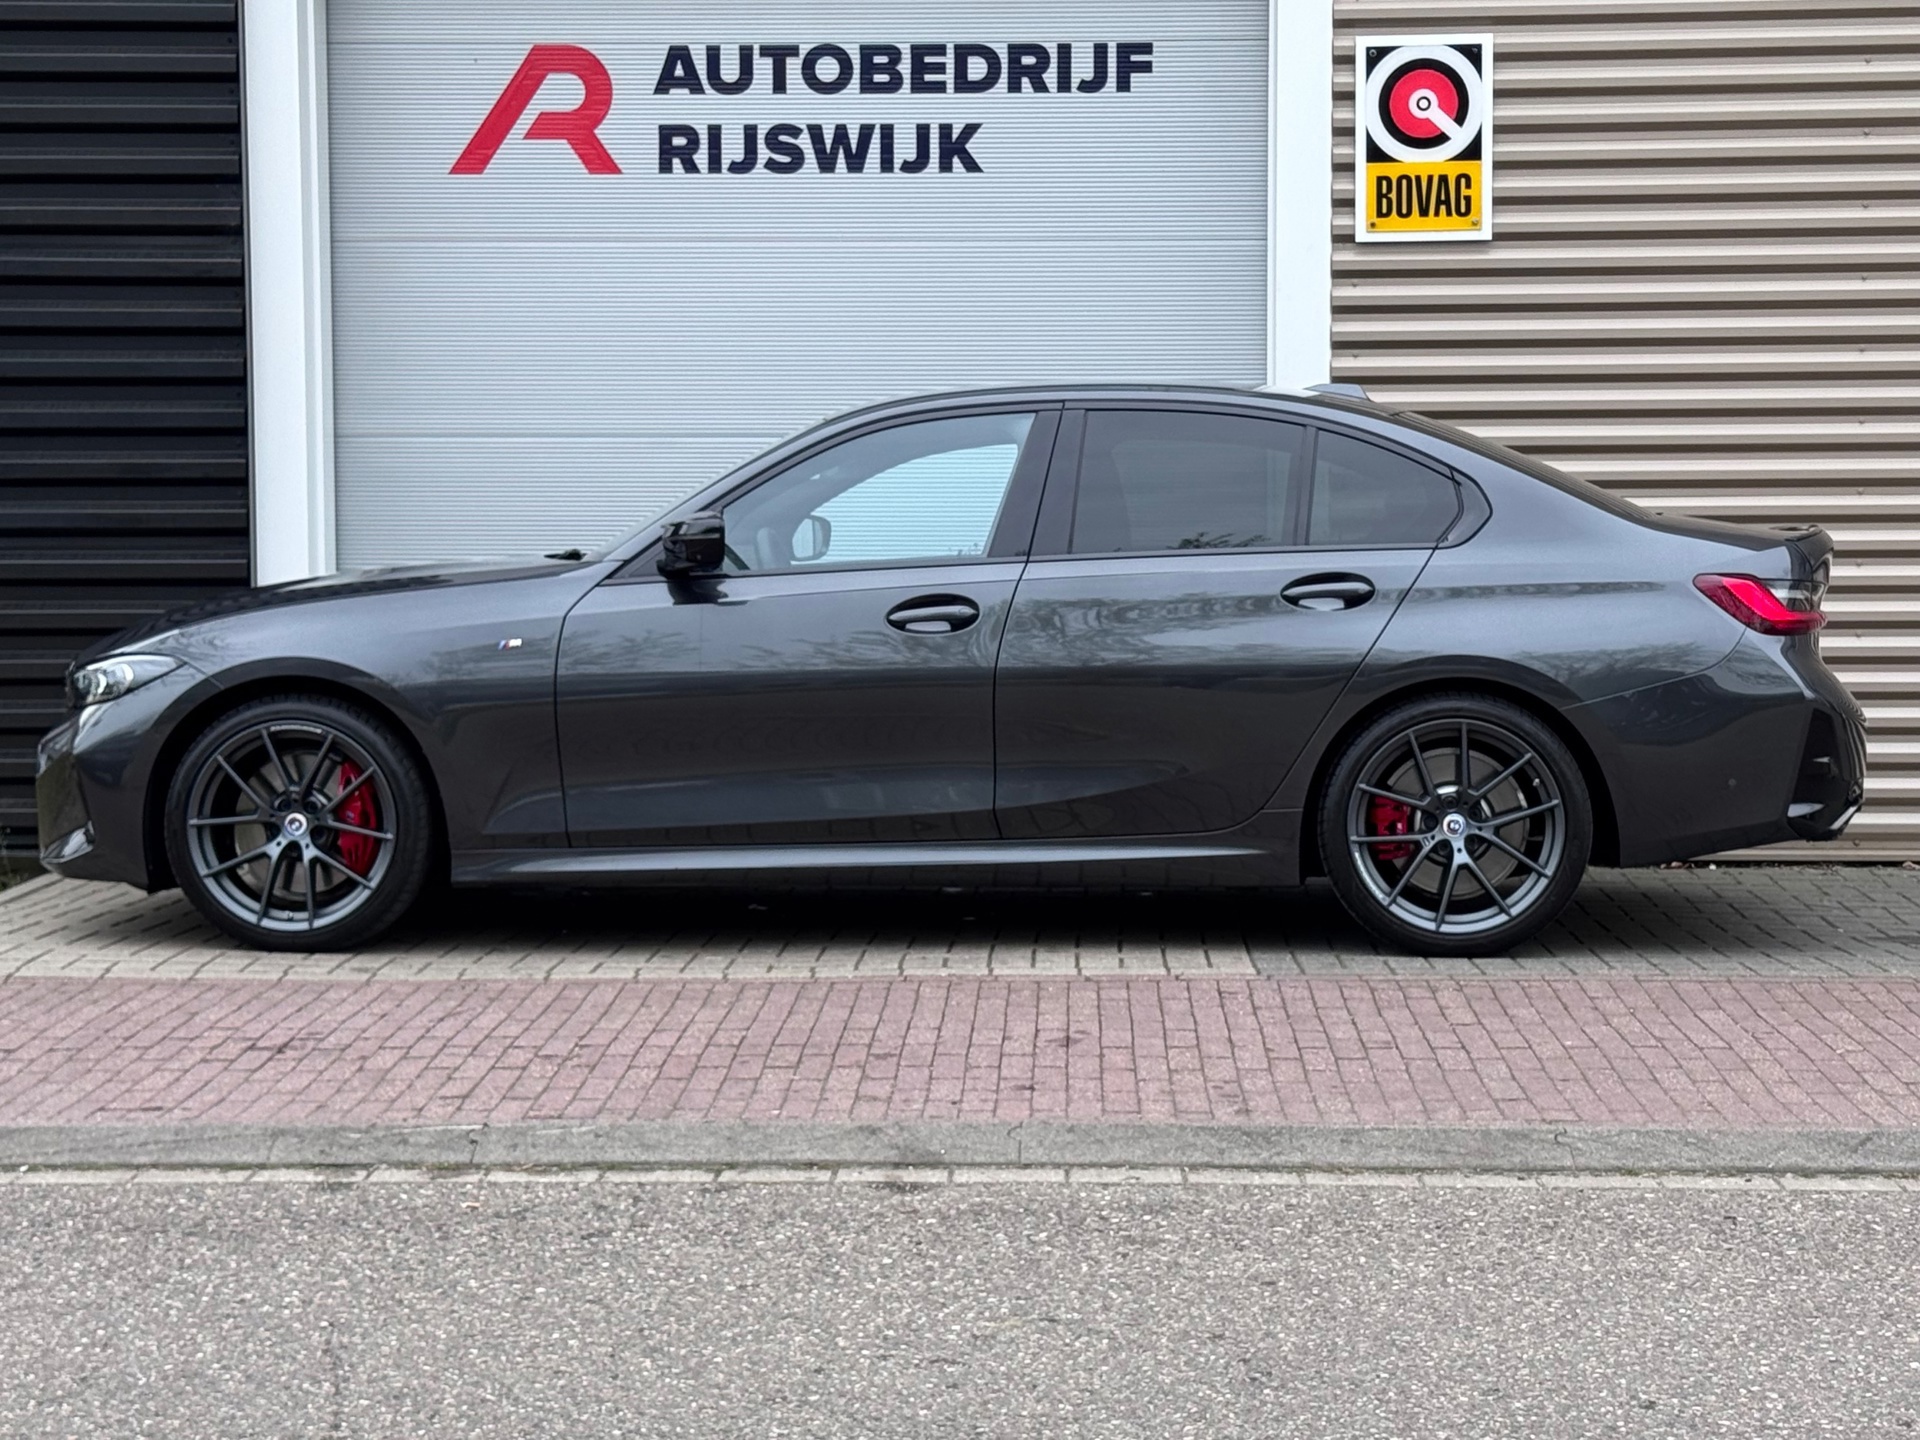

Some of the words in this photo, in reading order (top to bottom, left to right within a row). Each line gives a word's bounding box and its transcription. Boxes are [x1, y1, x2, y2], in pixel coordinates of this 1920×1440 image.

[653, 42, 1154, 96] AUTOBEDRIJF
[658, 123, 984, 175] RIJSWIJK
[1375, 172, 1472, 219] BOVAG
